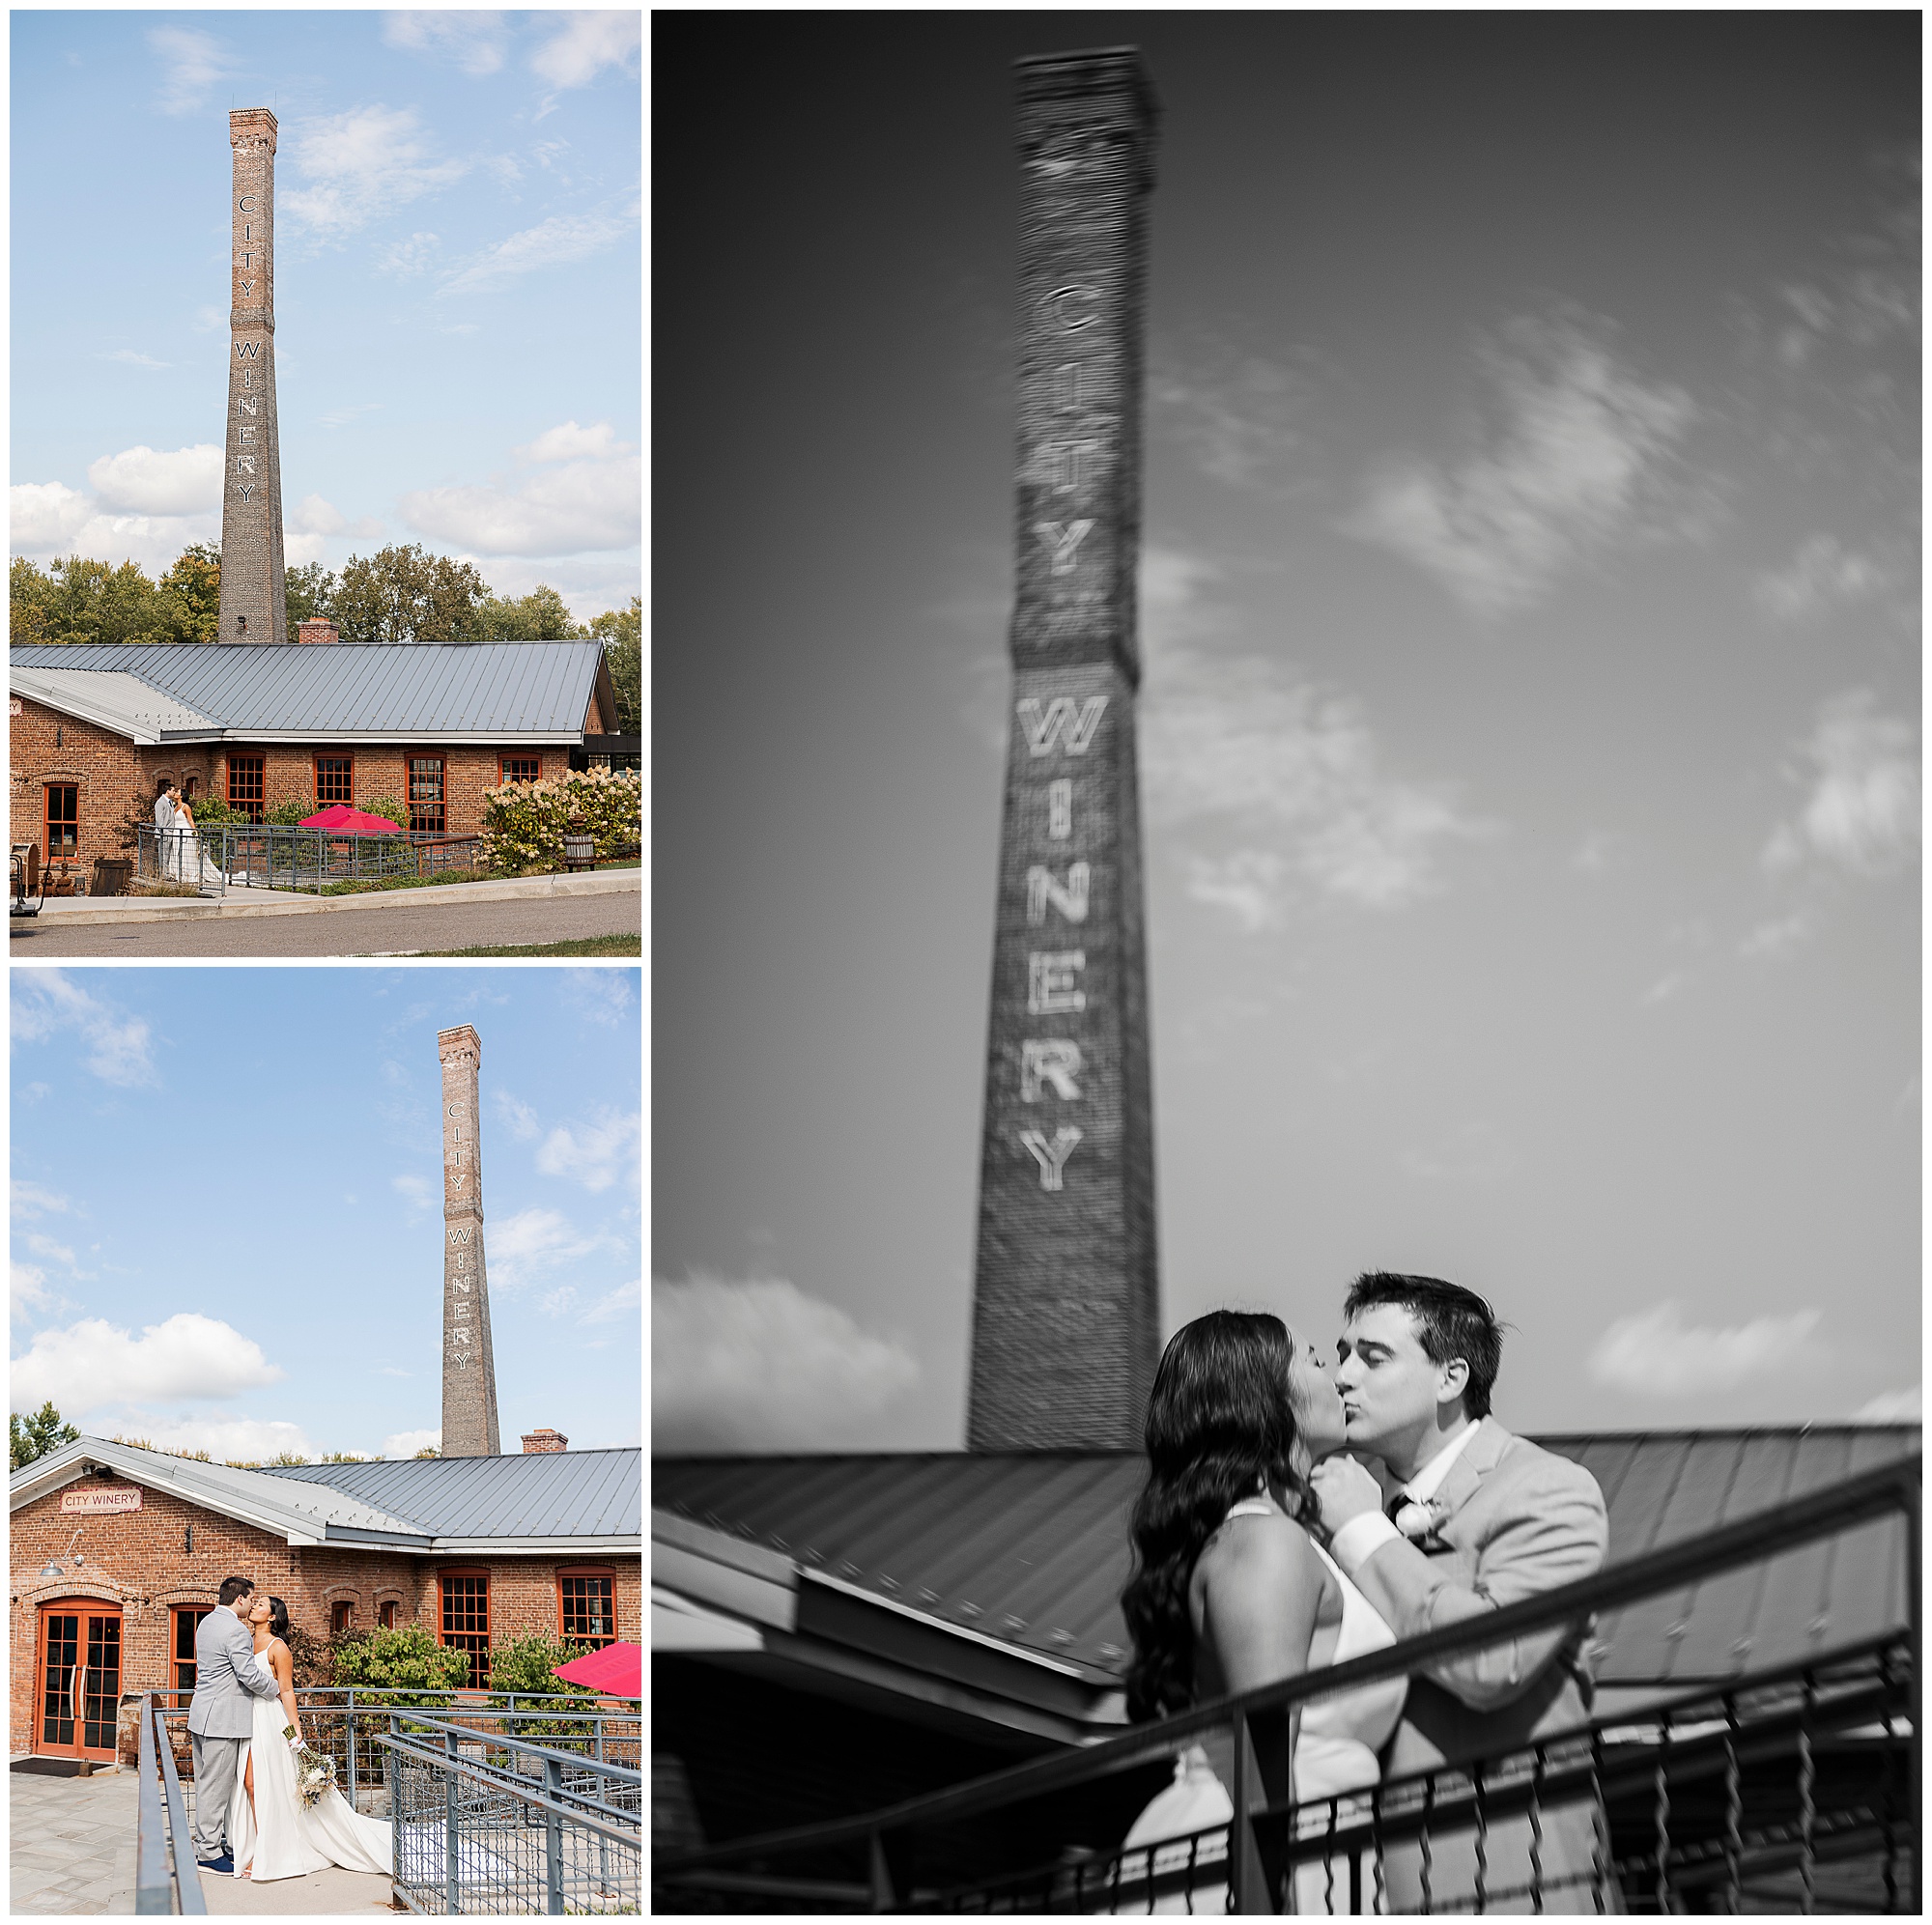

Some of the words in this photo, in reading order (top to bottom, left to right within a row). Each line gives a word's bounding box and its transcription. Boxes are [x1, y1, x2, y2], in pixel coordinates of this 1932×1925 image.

[238, 195, 257, 297] CITY
[235, 341, 262, 503] WINERY
[1032, 284, 1104, 576] CITY
[1015, 694, 1110, 1192] WINERY
[447, 1102, 468, 1191] CITY
[447, 1227, 472, 1370] WINERY
[65, 1496, 89, 1507] CITY
[92, 1493, 136, 1505] WINERY
